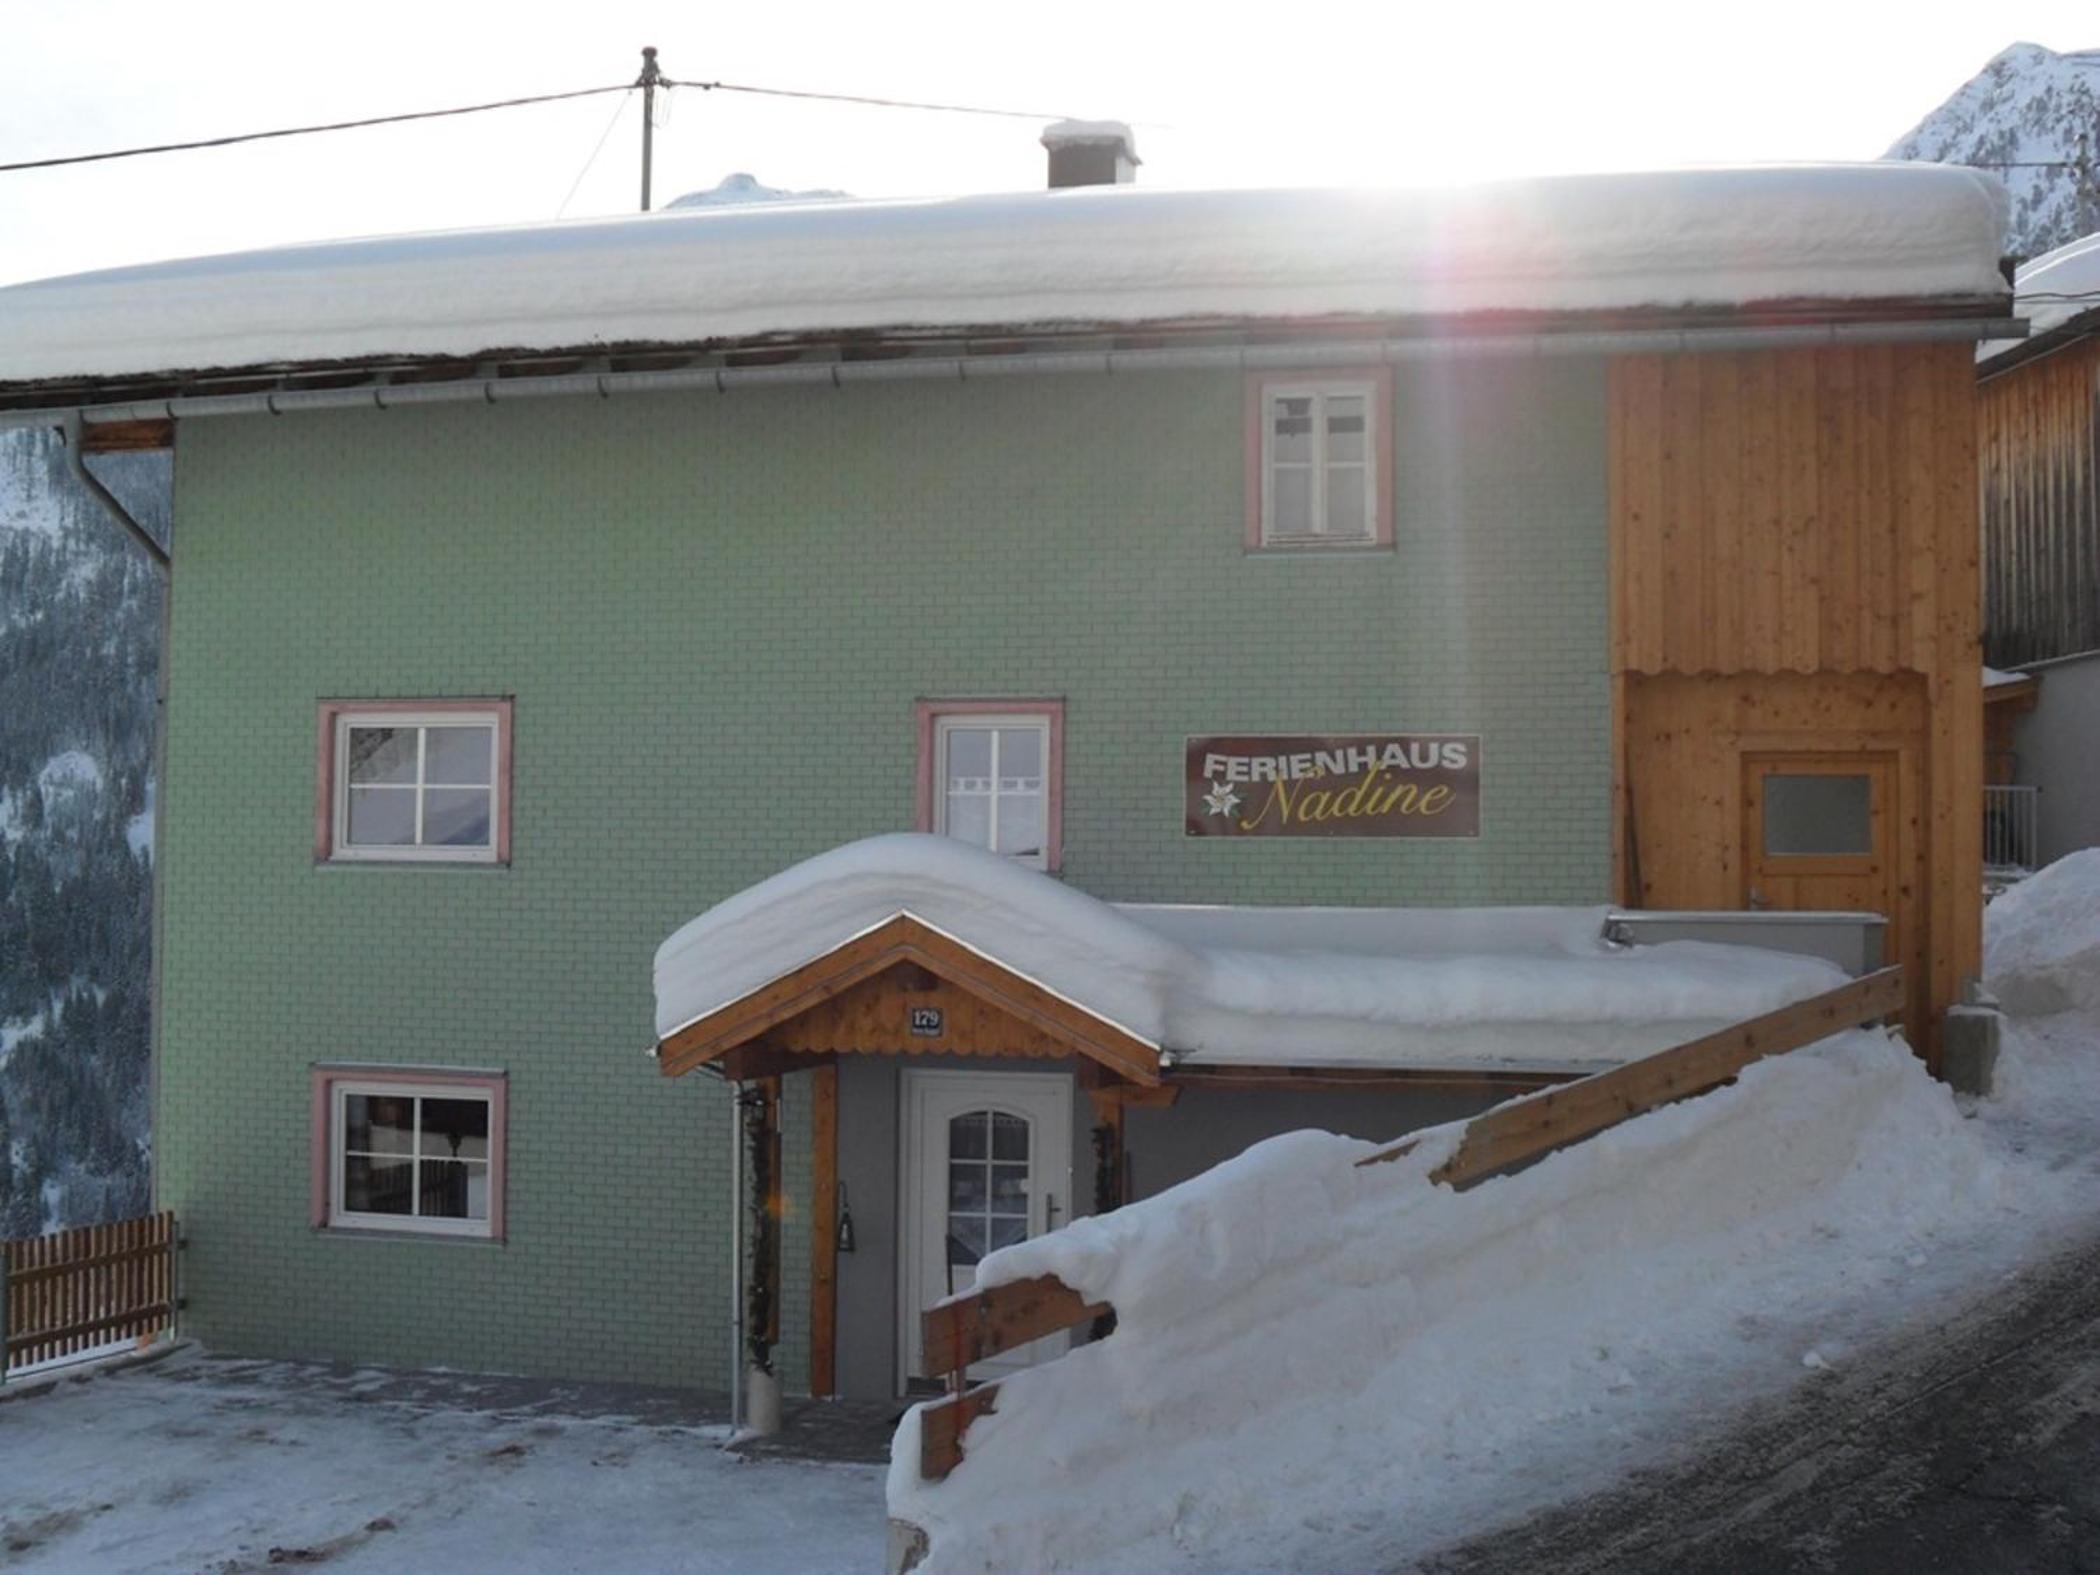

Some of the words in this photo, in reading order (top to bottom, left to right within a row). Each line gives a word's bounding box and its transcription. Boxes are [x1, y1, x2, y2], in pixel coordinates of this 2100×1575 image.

[1203, 742, 1468, 782] FERIENHAUS
[1240, 759, 1456, 830] Nadine
[914, 1009, 939, 1026] 179
